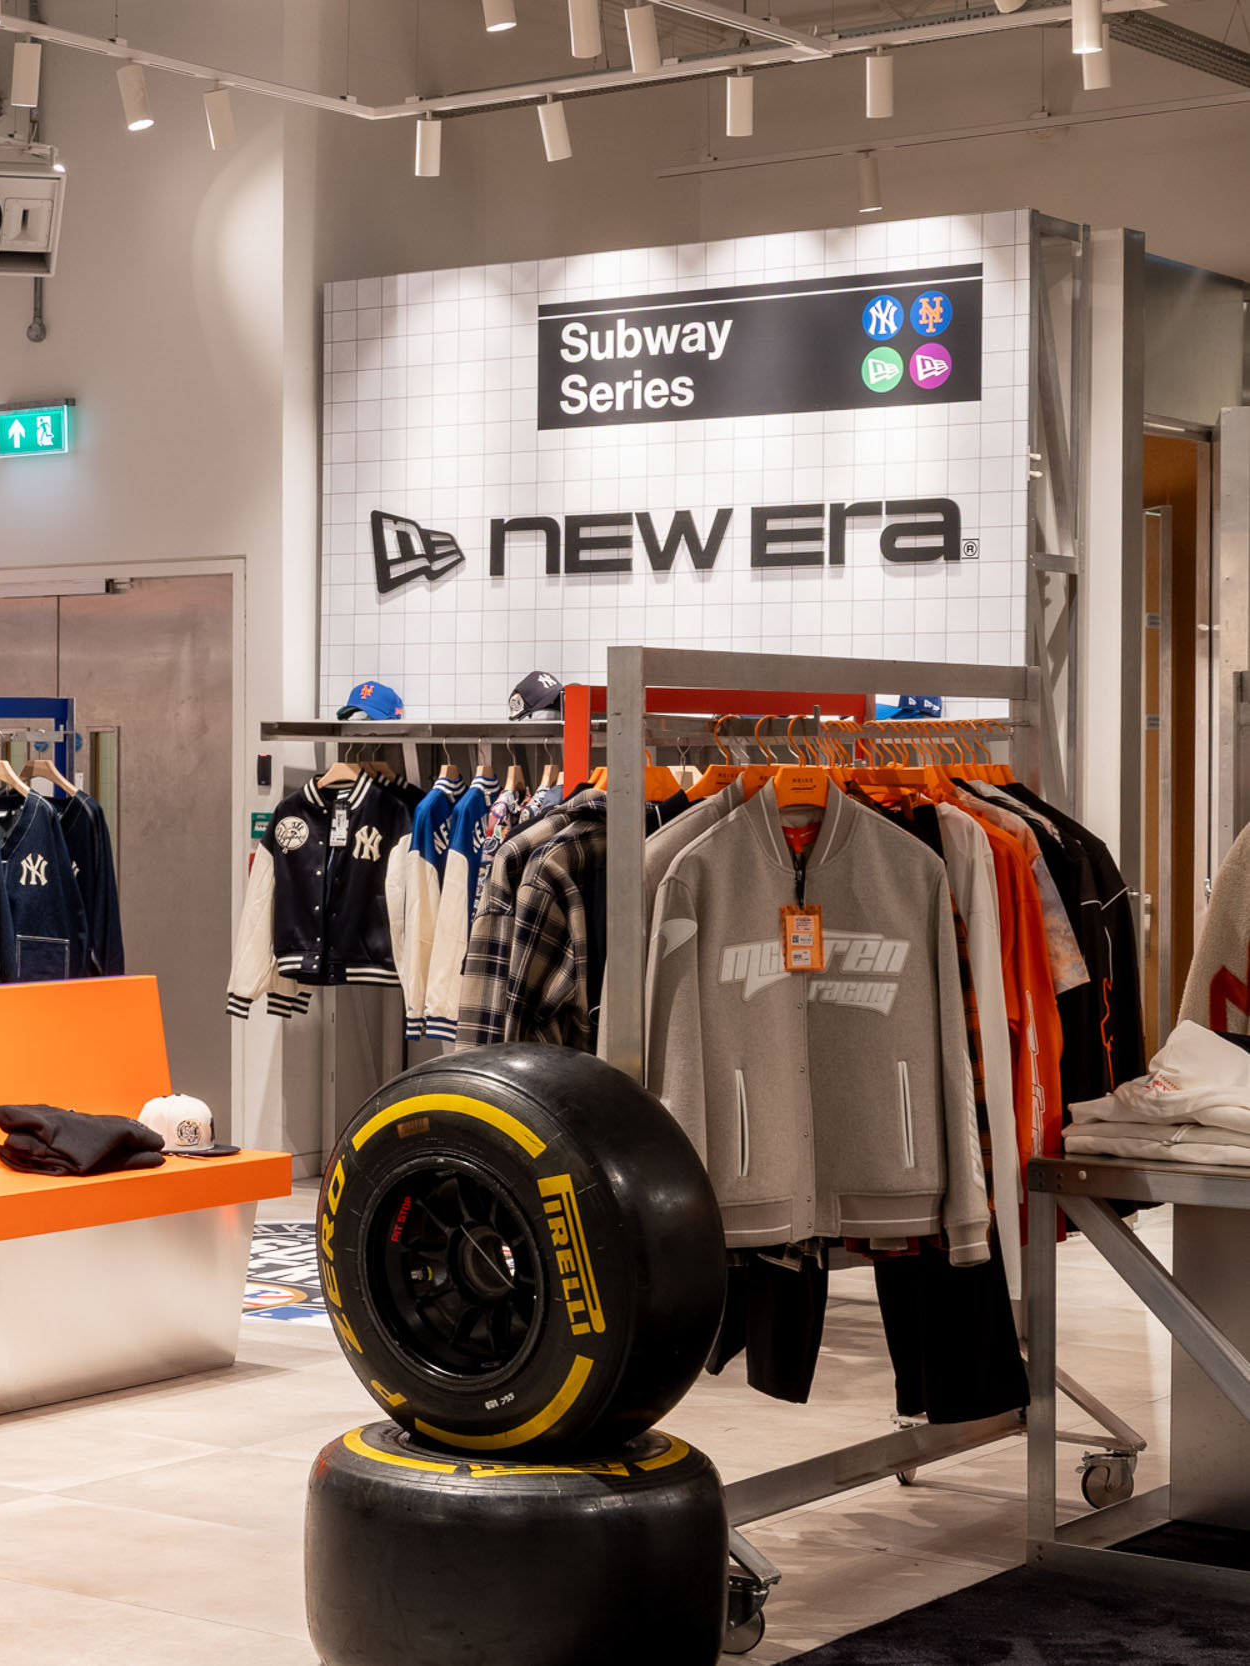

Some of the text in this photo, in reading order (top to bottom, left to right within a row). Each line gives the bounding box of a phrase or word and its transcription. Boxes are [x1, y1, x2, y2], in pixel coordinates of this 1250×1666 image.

[868, 299, 898, 335] NY
[560, 318, 733, 364] Subway
[559, 370, 695, 415] Series
[352, 825, 383, 862] NY
[19, 852, 49, 887] NY
[391, 1196, 412, 1243] PIT STOP
[321, 1159, 364, 1355] ZERO
[536, 1173, 607, 1336] PIRELLI
